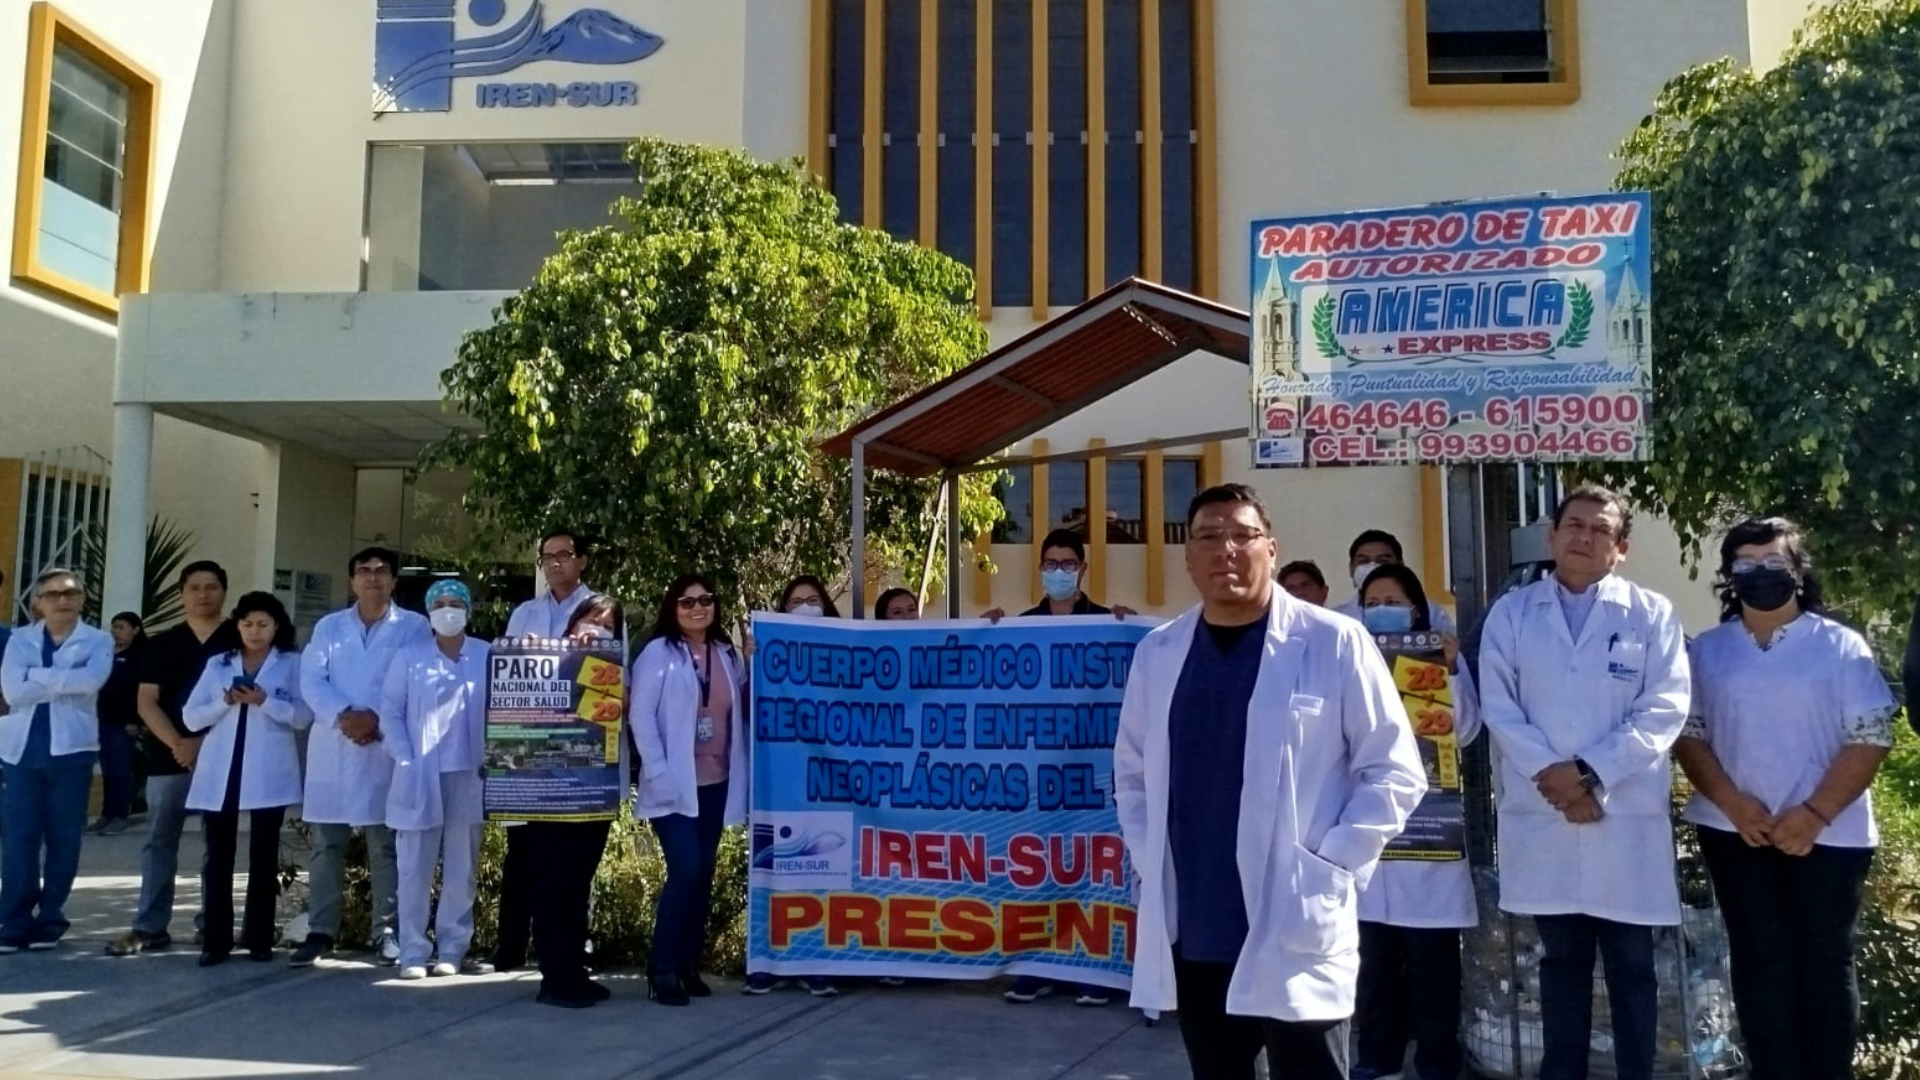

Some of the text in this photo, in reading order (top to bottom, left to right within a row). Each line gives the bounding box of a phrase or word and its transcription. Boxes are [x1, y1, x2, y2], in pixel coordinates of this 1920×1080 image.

[476, 81, 638, 108] IREN-SUR
[1259, 202, 1641, 257] PARADERO DE TAXI
[1291, 243, 1605, 281] AUTORIZADO
[1337, 279, 1564, 335] AMERICA
[1398, 332, 1552, 355] EXPRESS
[1262, 365, 1640, 397] Honradez Puntualidad y Responsabilidad
[1304, 400, 1449, 431] 464646
[1486, 395, 1639, 426] 615900
[1310, 430, 1634, 460] CEL.: 993904466
[493, 658, 554, 680] PARO
[590, 664, 621, 686] 28
[764, 638, 901, 690] CUERPO
[910, 635, 1041, 690] MÉDICO
[1405, 664, 1447, 691] 28
[493, 680, 570, 693] NACIONAL DEL
[491, 696, 568, 708] SECTOR SALUD
[592, 701, 621, 722] 29
[757, 697, 913, 748] REGIONAL
[921, 703, 966, 749] DE
[1415, 709, 1453, 736] 29
[1439, 741, 1454, 781] MAYO
[807, 752, 1028, 811] NEOPLÁSICAS
[1037, 764, 1105, 811] DEL
[775, 860, 829, 871] IREN-SUR
[860, 827, 1125, 889] IREN-SUR
